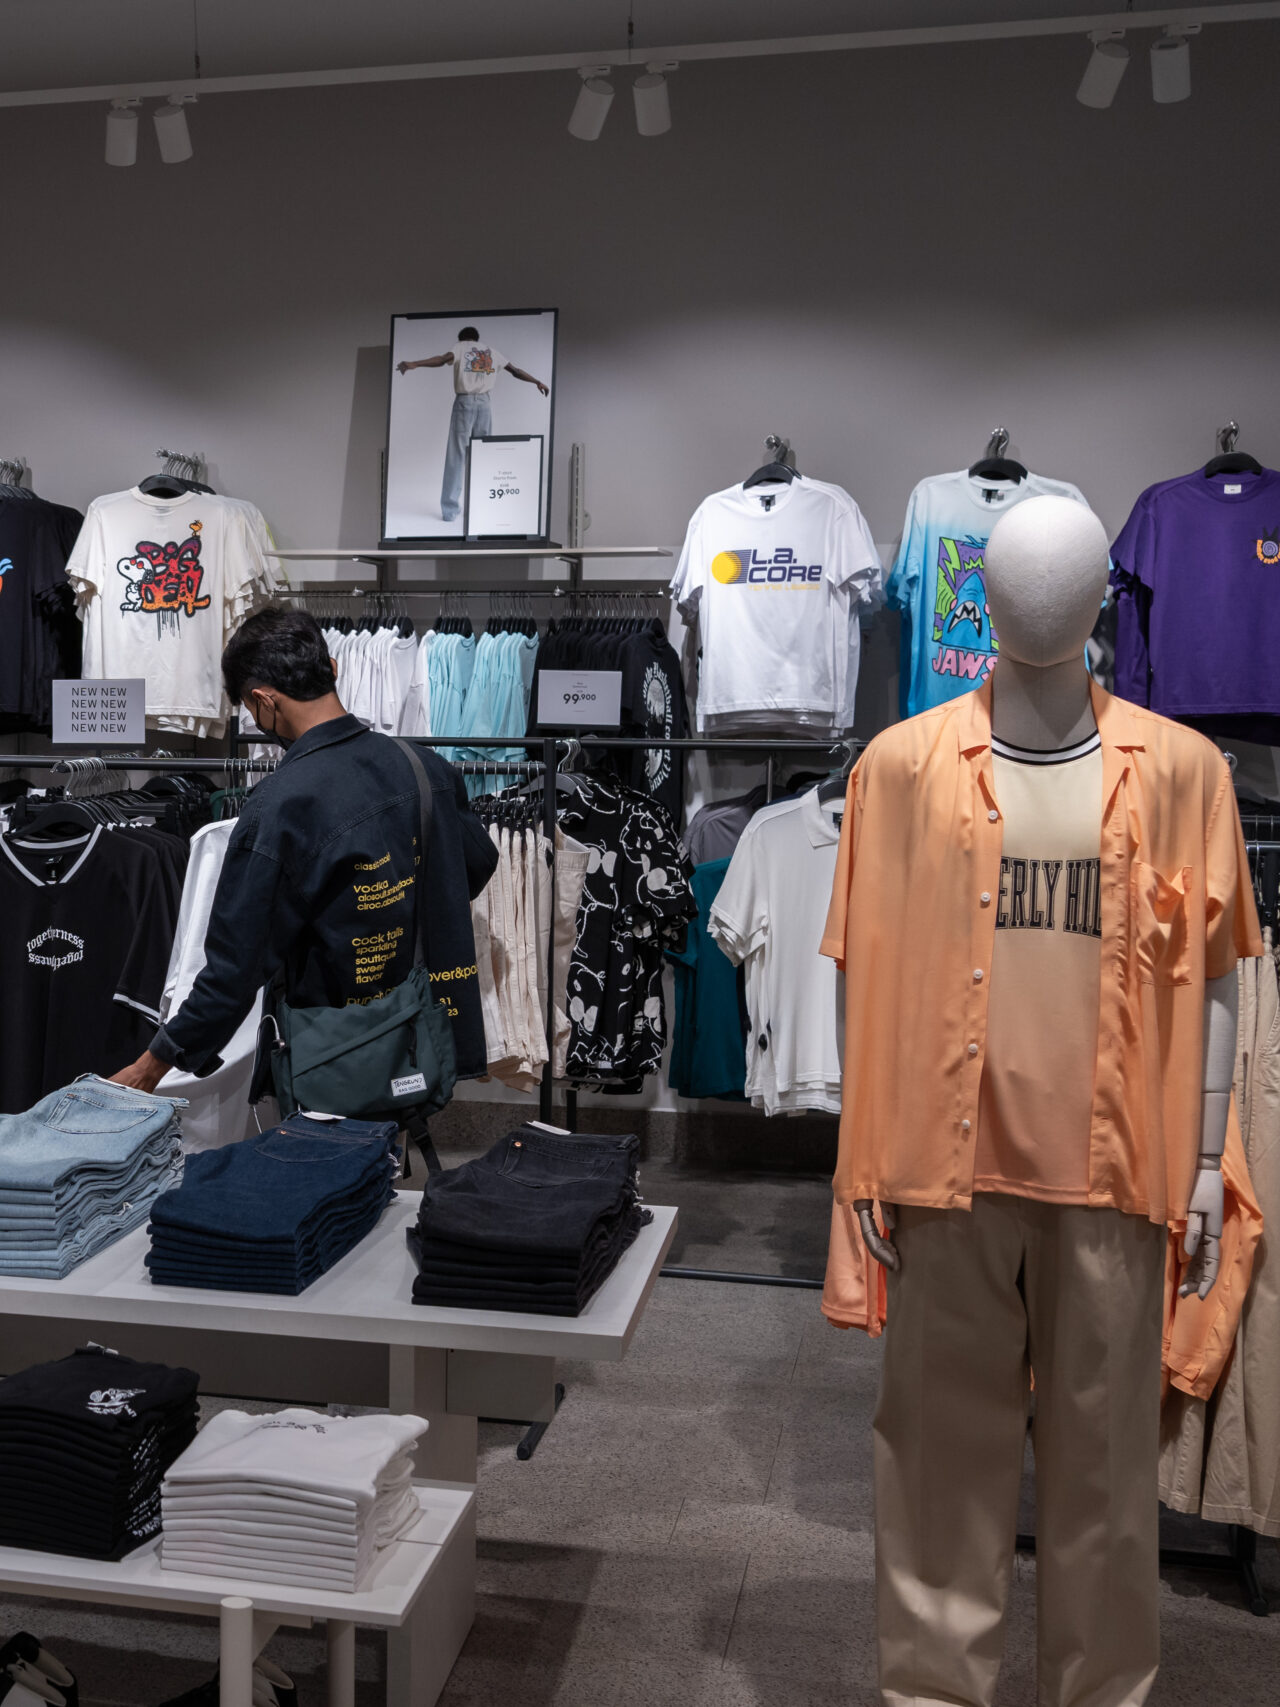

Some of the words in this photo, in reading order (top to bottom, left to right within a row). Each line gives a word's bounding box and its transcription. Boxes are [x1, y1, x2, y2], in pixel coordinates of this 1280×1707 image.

[71, 687, 97, 696] NEW
[100, 687, 127, 696] NEW
[71, 699, 97, 708] NEW
[100, 699, 127, 708] NEW
[71, 711, 97, 720] NEW
[100, 711, 127, 720] NEW
[71, 723, 97, 732] NEW
[100, 723, 127, 732] NEW
